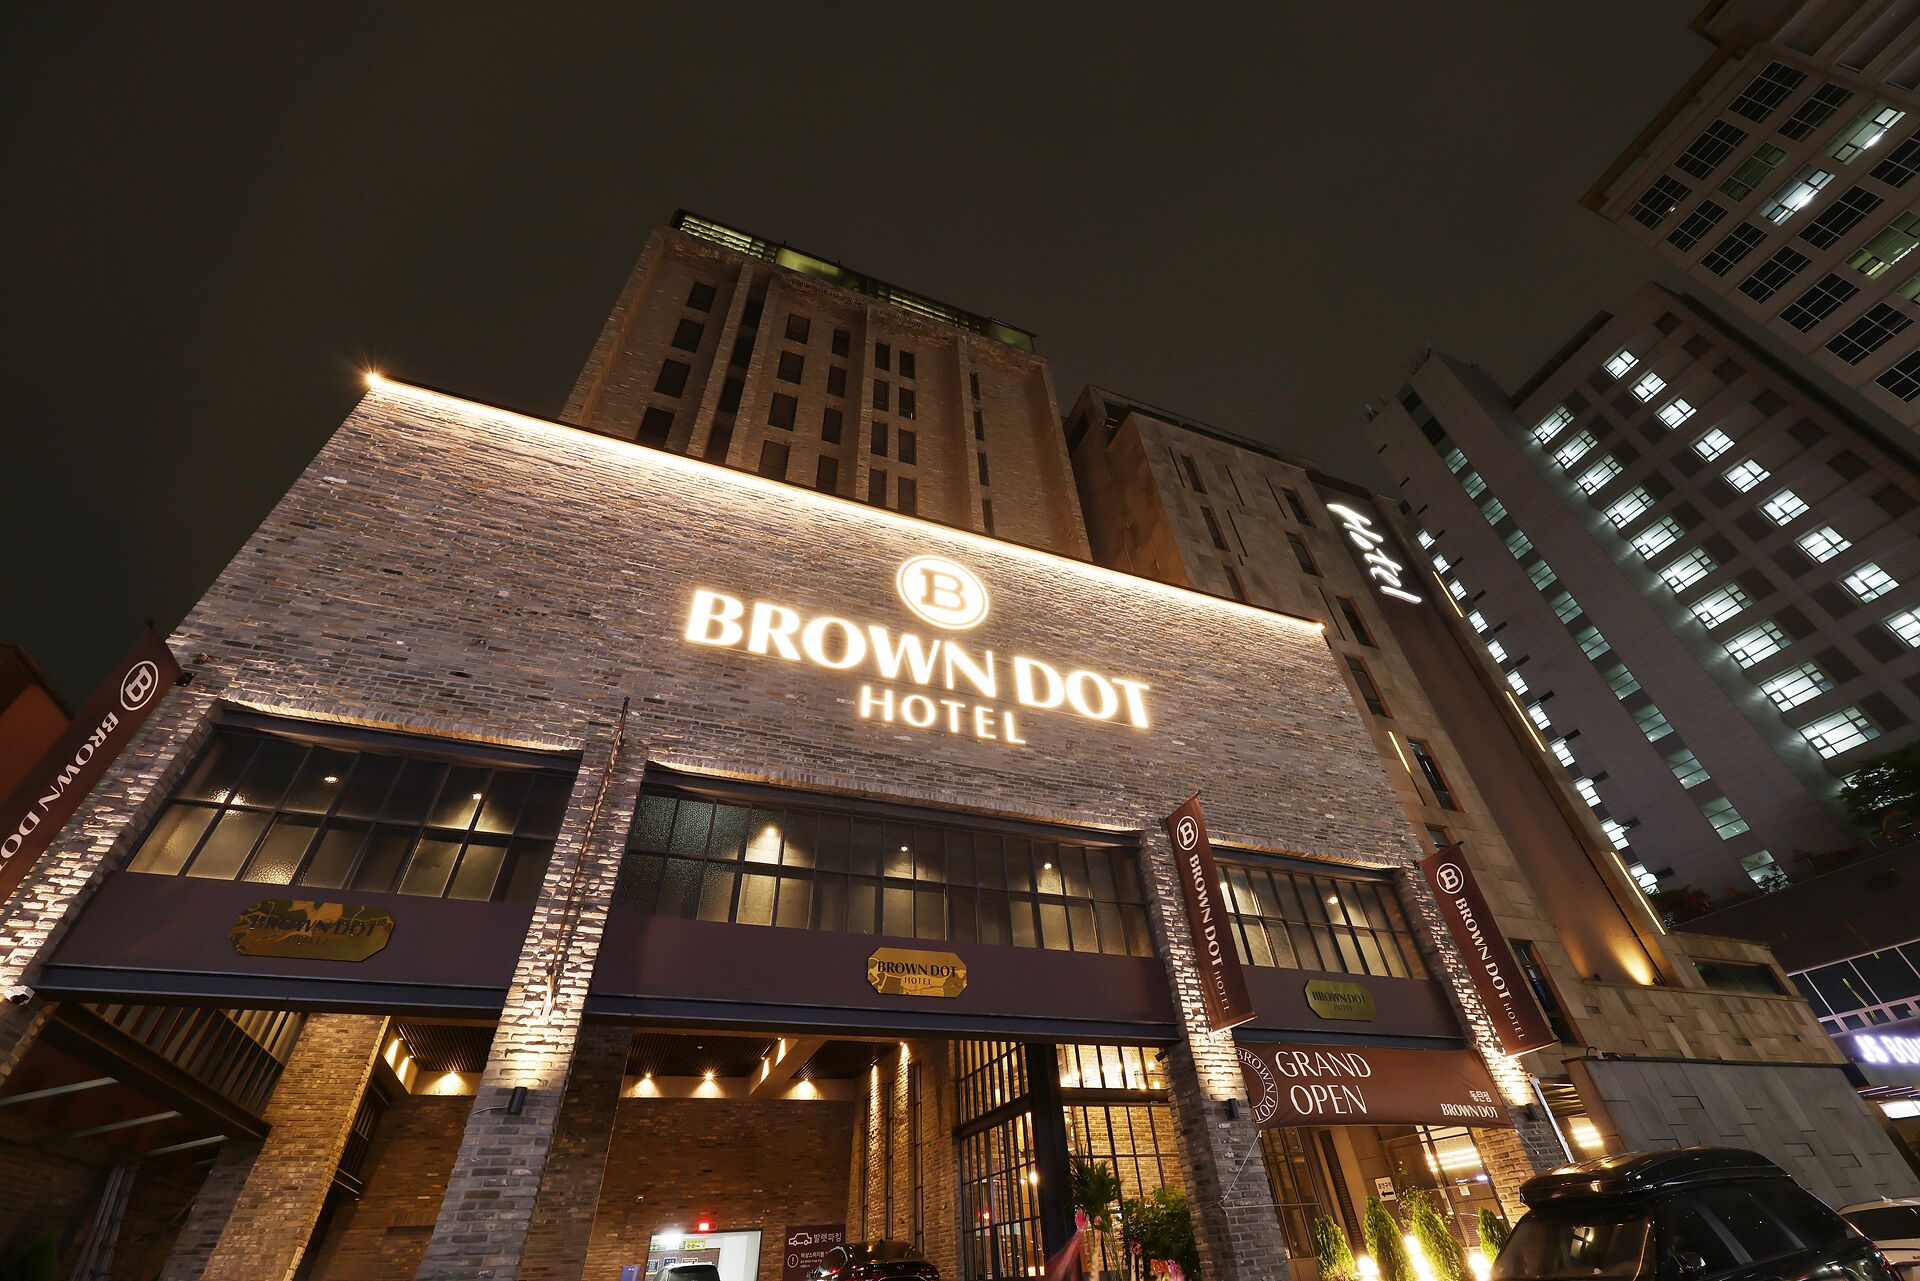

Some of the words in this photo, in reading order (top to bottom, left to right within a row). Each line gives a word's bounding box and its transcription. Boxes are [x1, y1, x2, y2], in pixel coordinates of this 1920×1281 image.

[1326, 503, 1422, 604] Hotel
[919, 567, 967, 613] B
[685, 588, 997, 698] BROWN
[1013, 655, 1151, 730] DOT
[860, 685, 1026, 745] HOTEL
[38, 711, 119, 812] BROWN
[1188, 853, 1214, 924] BROWN
[1204, 922, 1225, 967] DOT
[877, 960, 928, 976] BROWN
[930, 964, 957, 978] DOT
[904, 976, 932, 985] HOTEL
[1455, 897, 1492, 962] BROWN
[1484, 961, 1513, 1000] DOT
[1503, 1002, 1525, 1041] HOTEL
[1213, 970, 1231, 1014] HOTEL
[1312, 991, 1348, 1003] BROWN
[1347, 993, 1366, 1005] DOT
[1275, 1050, 1372, 1078] GRAND
[1289, 1084, 1368, 1115] OPEN
[1440, 1103, 1480, 1118] BROWN
[1477, 1105, 1499, 1119] DOT
[813, 1232, 842, 1244] 발렛파킹
